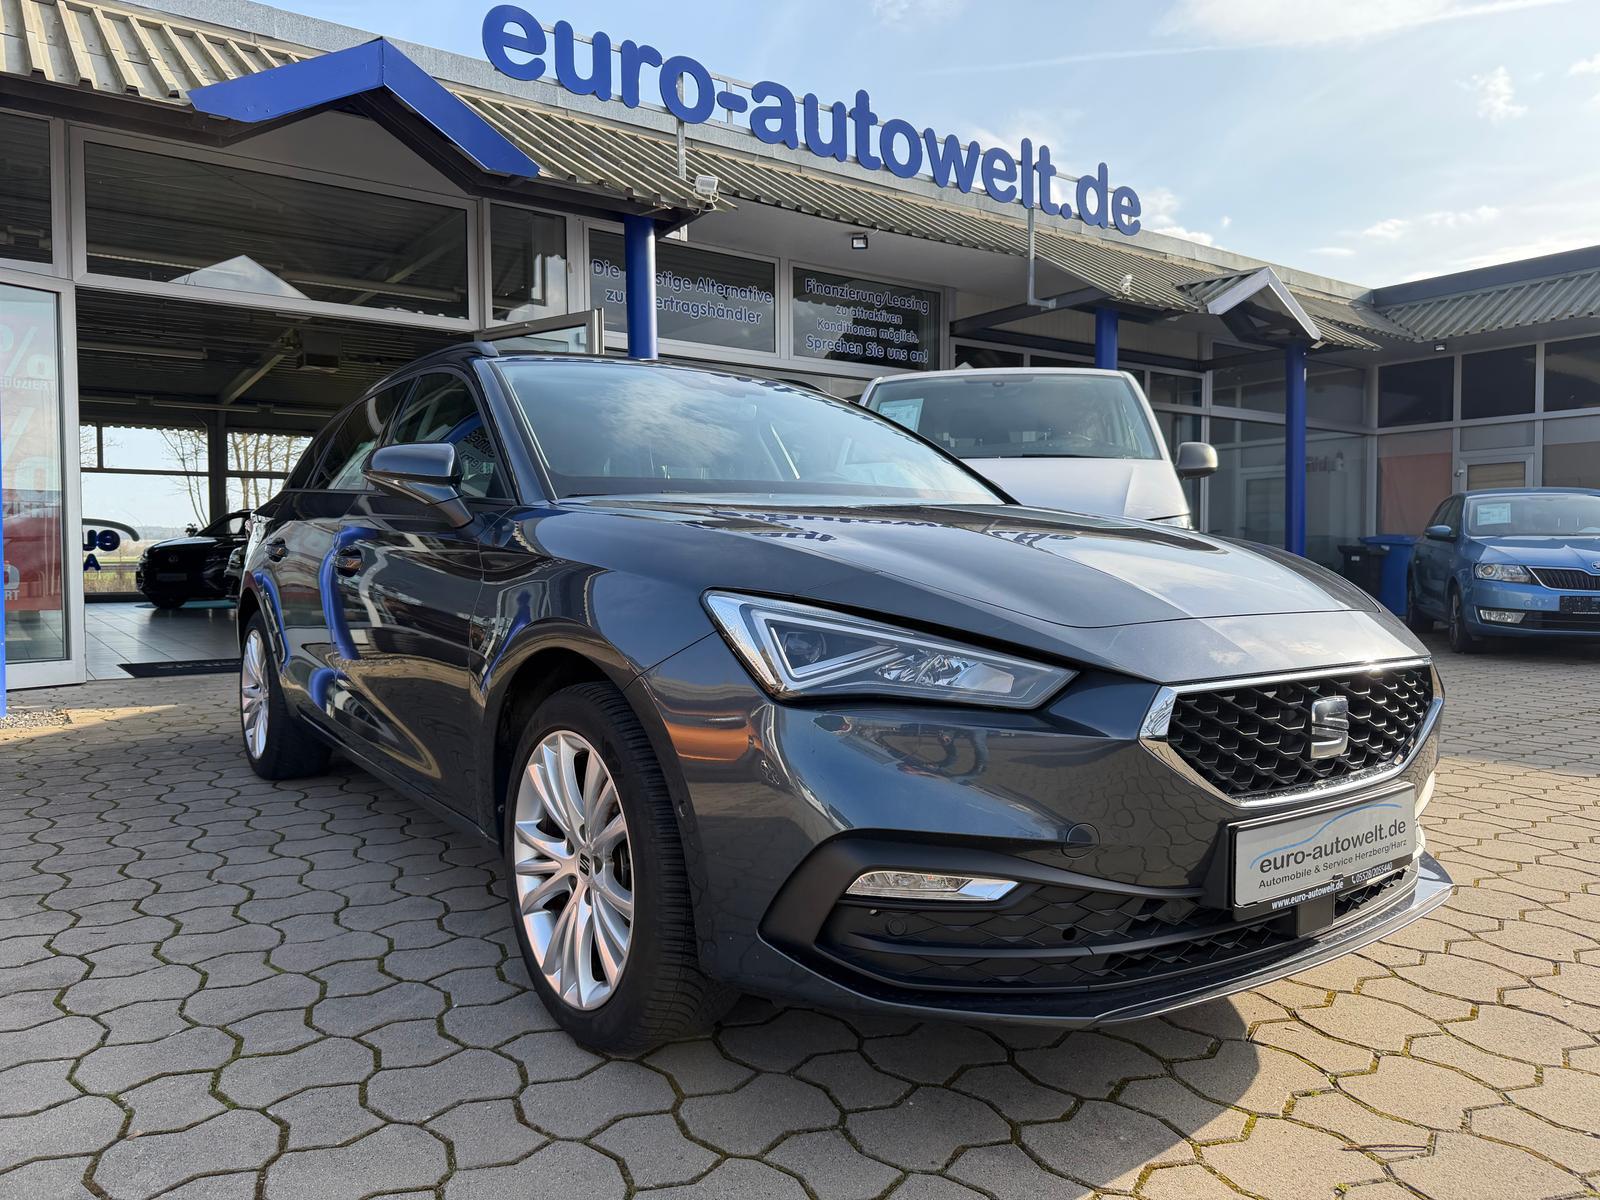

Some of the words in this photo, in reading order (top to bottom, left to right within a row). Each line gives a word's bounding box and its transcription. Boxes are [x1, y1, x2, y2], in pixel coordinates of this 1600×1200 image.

[482, 5, 1142, 236] euro-autowelt.de
[592, 259, 620, 279] Die
[696, 278, 774, 305] Alternative
[804, 278, 930, 315] Finanzierung/Leasing
[605, 288, 627, 304] zu
[656, 296, 762, 325] ertragshändler
[835, 304, 847, 315] zu
[850, 306, 903, 325] attraktiven
[816, 317, 878, 338] Konditionen
[805, 333, 864, 354] Sprechen
[865, 342, 885, 358] Sie
[887, 347, 908, 361] uns
[909, 348, 929, 364] an!
[1258, 868, 1312, 889] Automobile
[1313, 865, 1321, 874] &
[1322, 856, 1353, 871] Service
[1354, 839, 1407, 861] Herzberg/Harz
[1259, 818, 1406, 874] euro-autowelt.de
[1271, 880, 1344, 910] www.euro-autowelt.de
